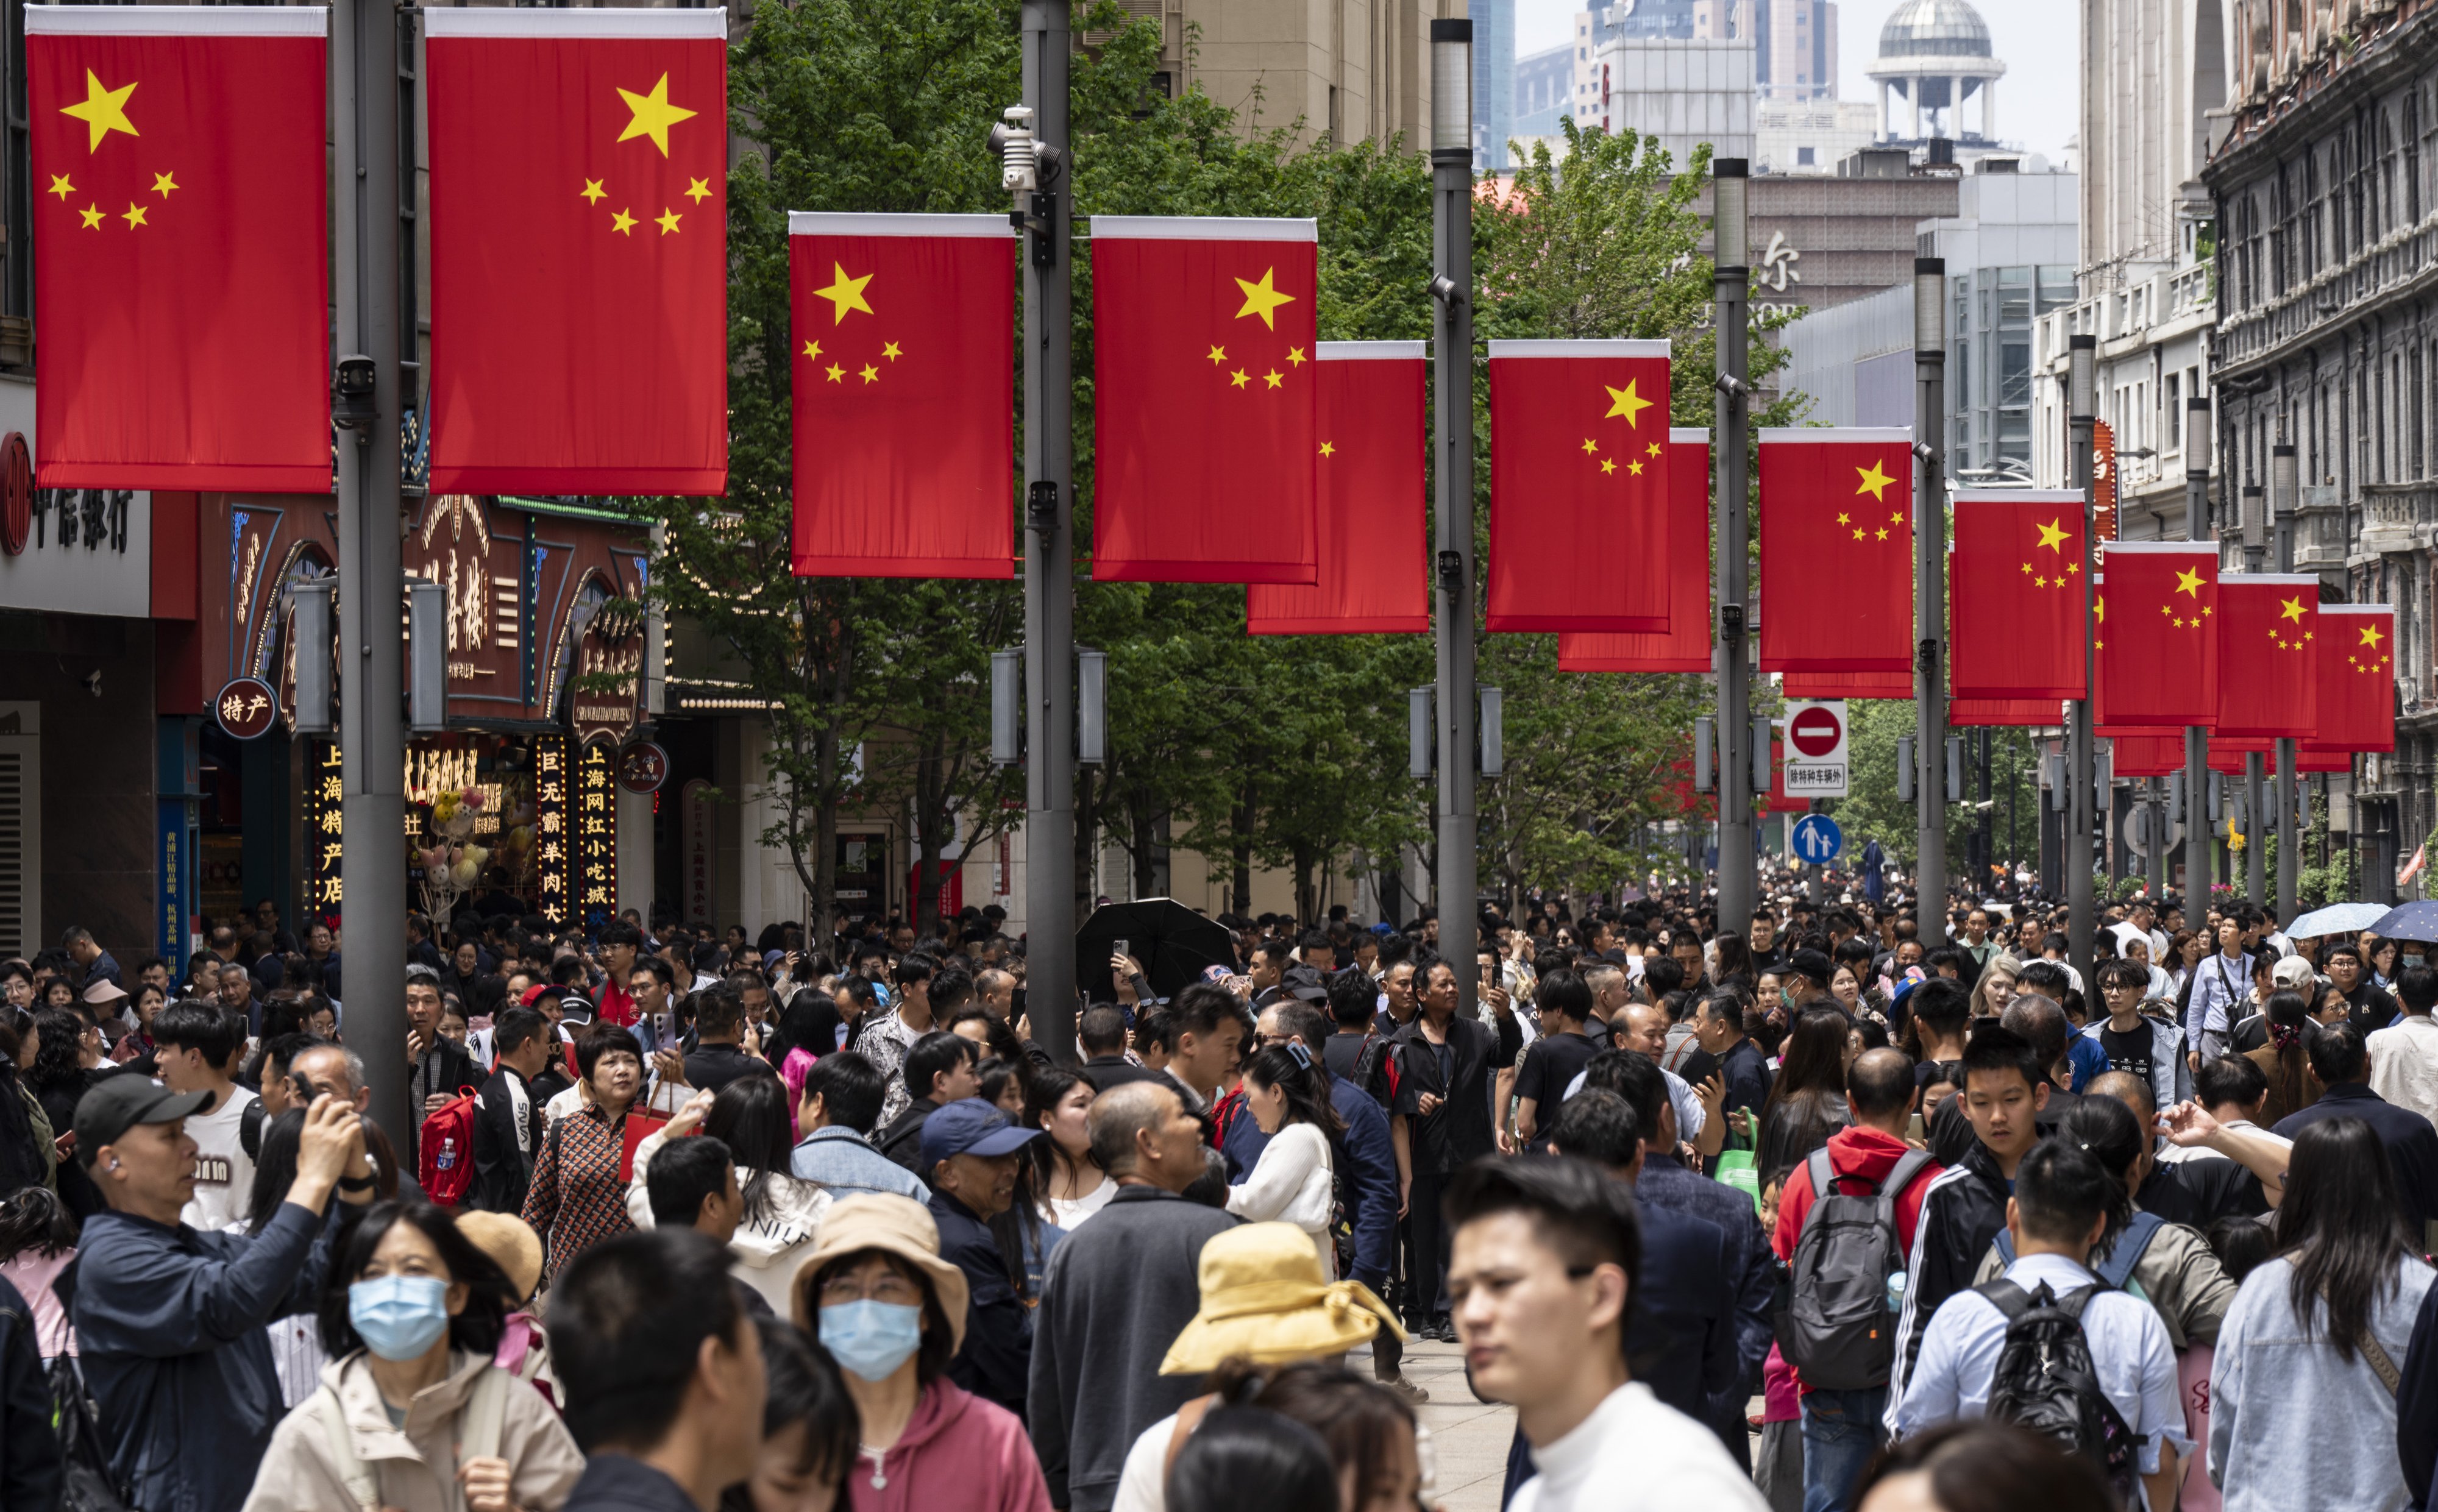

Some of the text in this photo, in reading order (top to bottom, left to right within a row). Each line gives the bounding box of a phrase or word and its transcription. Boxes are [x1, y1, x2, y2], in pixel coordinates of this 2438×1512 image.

[1761, 229, 1801, 292] 尔
[423, 548, 483, 653] 喜楼
[222, 694, 268, 723] 特产
[624, 754, 659, 775] 夜宵
[1790, 768, 1842, 790] 除特种车辆外
[322, 745, 343, 904] 上海特产店
[586, 745, 608, 904] 上海网红小吃城
[692, 842, 706, 924] 上海美食小吃
